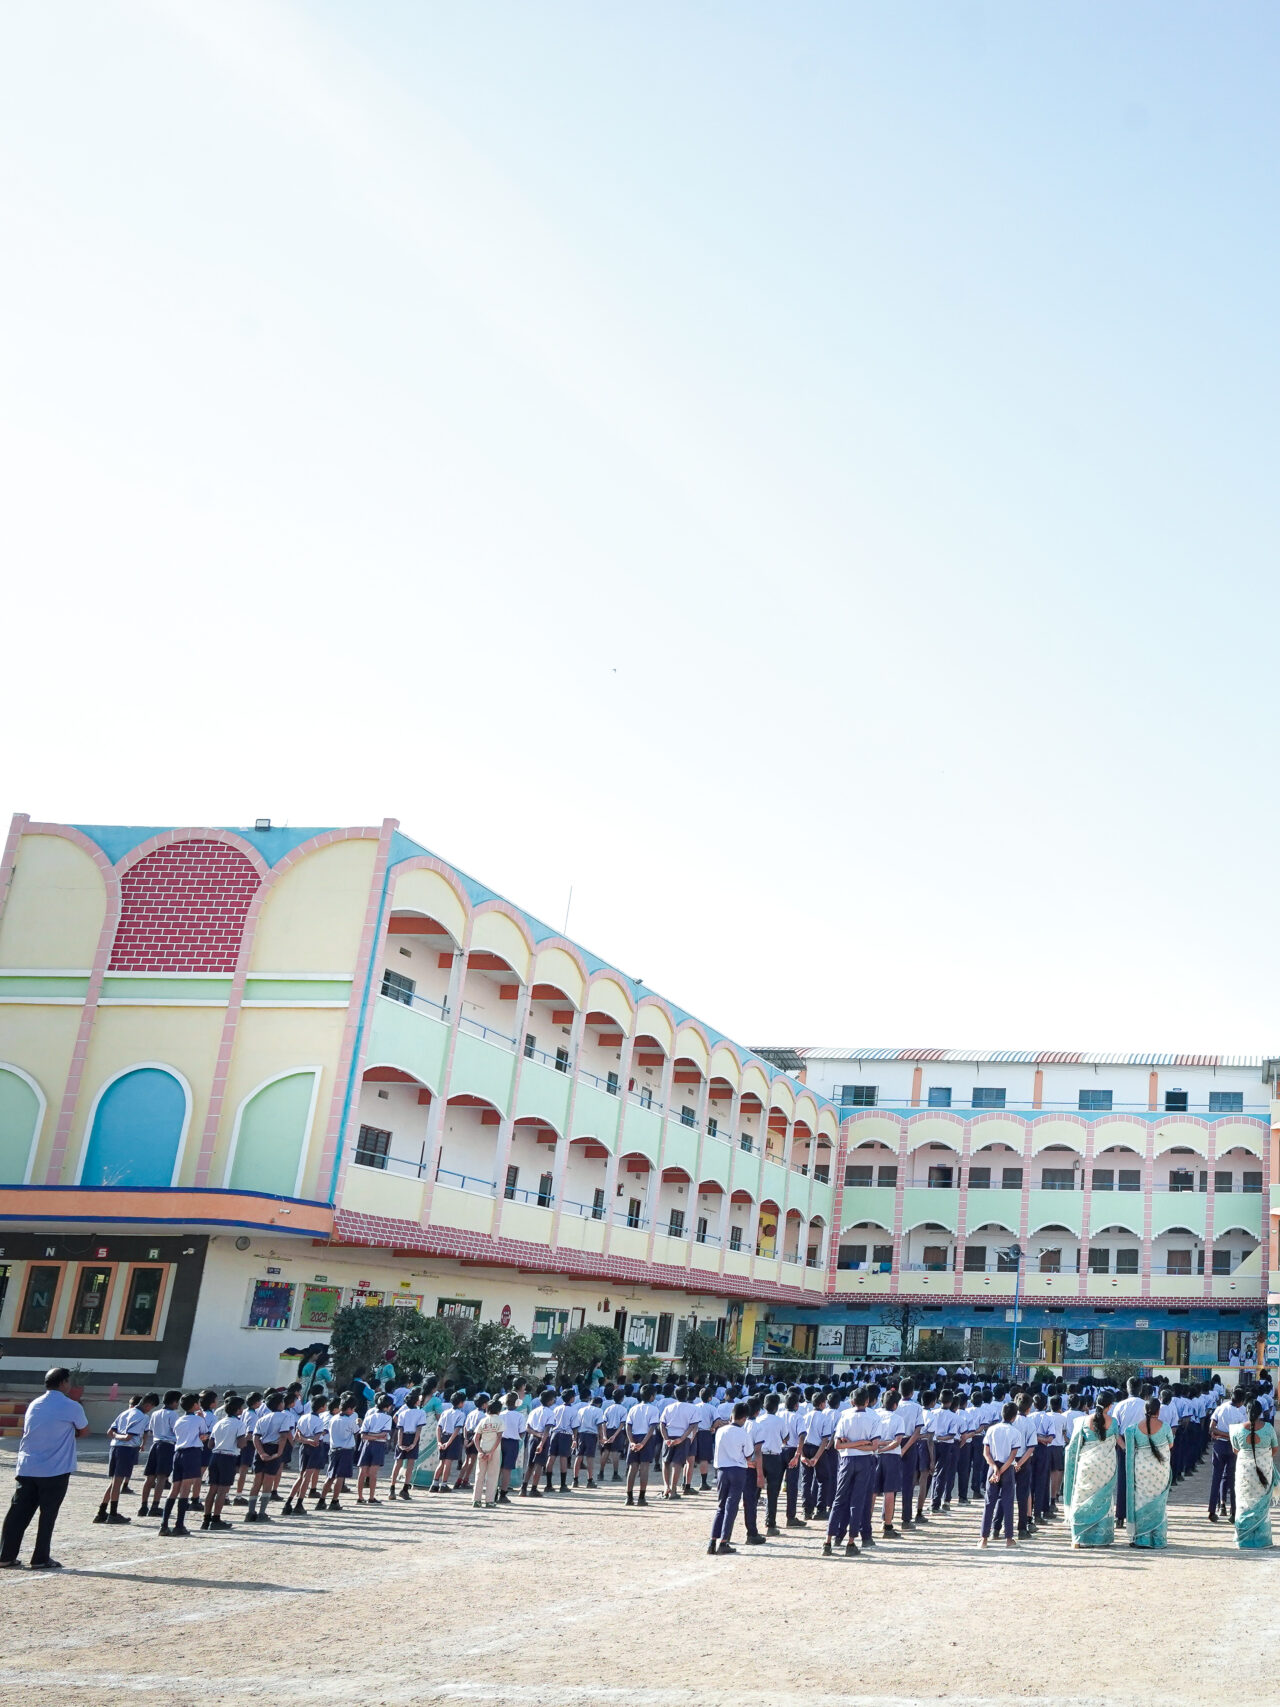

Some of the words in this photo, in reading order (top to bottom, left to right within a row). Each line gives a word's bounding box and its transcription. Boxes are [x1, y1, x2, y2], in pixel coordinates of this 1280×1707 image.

[45, 1247, 56, 1257] N
[97, 1248, 108, 1258] S
[149, 1249, 159, 1259] R
